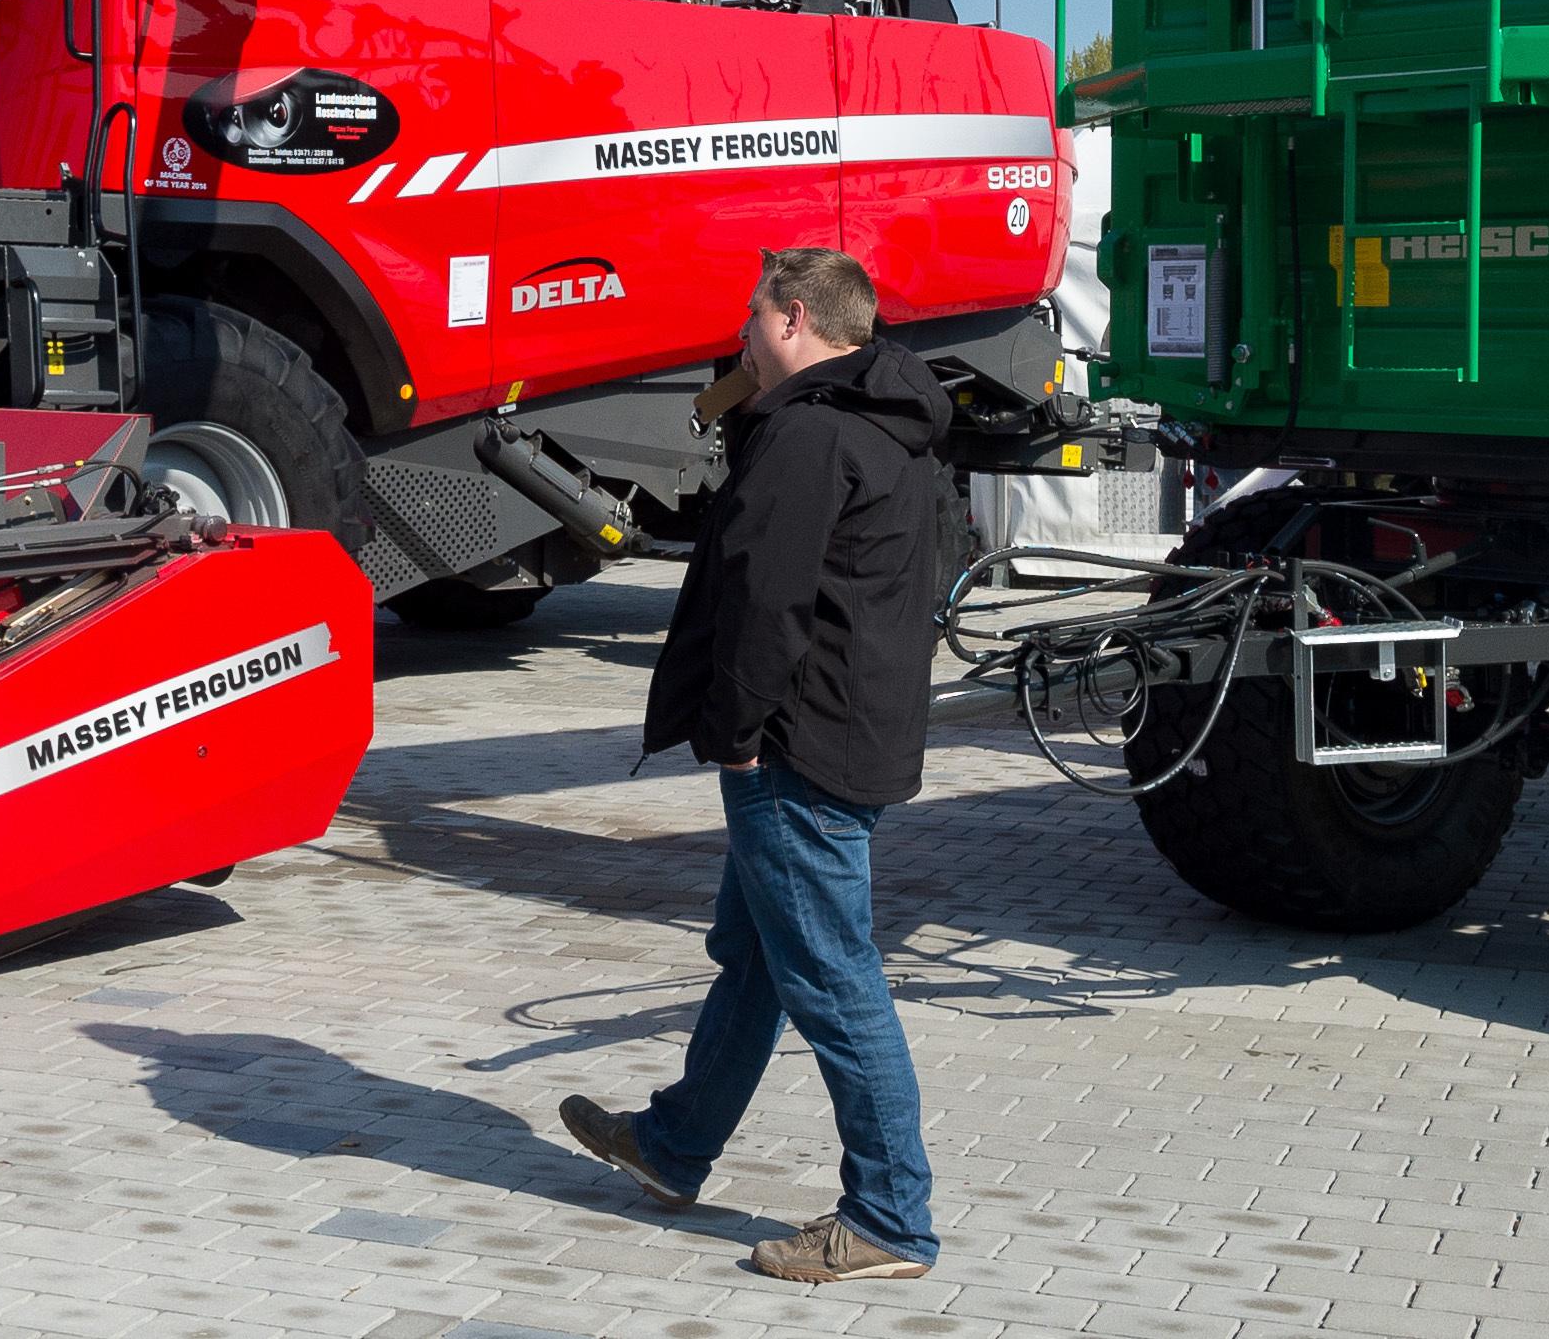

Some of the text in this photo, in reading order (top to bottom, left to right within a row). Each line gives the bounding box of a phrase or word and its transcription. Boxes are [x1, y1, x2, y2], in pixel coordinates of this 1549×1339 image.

[595, 129, 839, 171] MASSEY FERGUSON
[156, 179, 169, 188] THE
[170, 181, 190, 189] YEAR
[160, 171, 192, 180] MACHINE
[987, 164, 1052, 190] 9380
[1011, 204, 1026, 228] 20
[511, 273, 626, 313] DELTA
[26, 642, 303, 771] MASSEY FERGUSON
